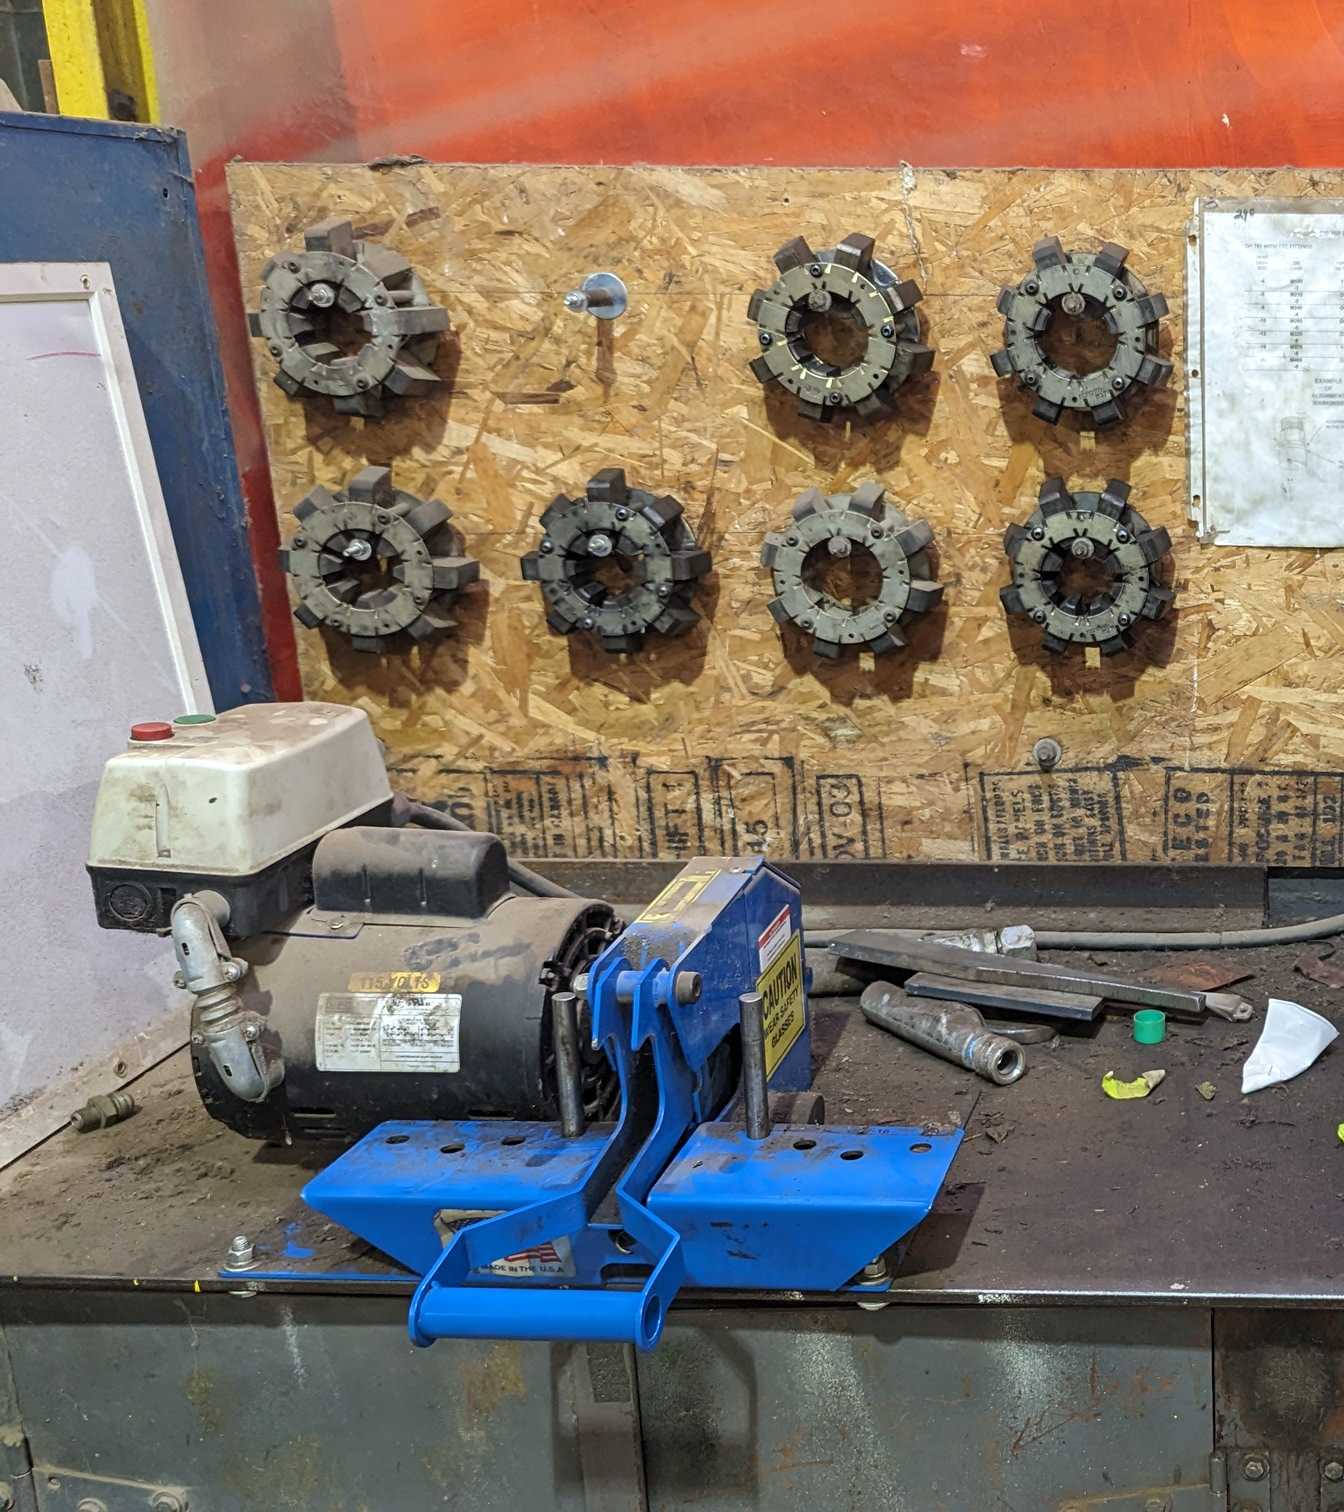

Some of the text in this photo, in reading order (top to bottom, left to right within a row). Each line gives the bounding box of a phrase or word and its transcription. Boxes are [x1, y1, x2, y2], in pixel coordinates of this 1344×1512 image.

[761, 952, 799, 1021] CAUTION
[779, 984, 801, 1018] SAFETY
[771, 1009, 796, 1048] GLASSES
[519, 1265, 537, 1273] THE
